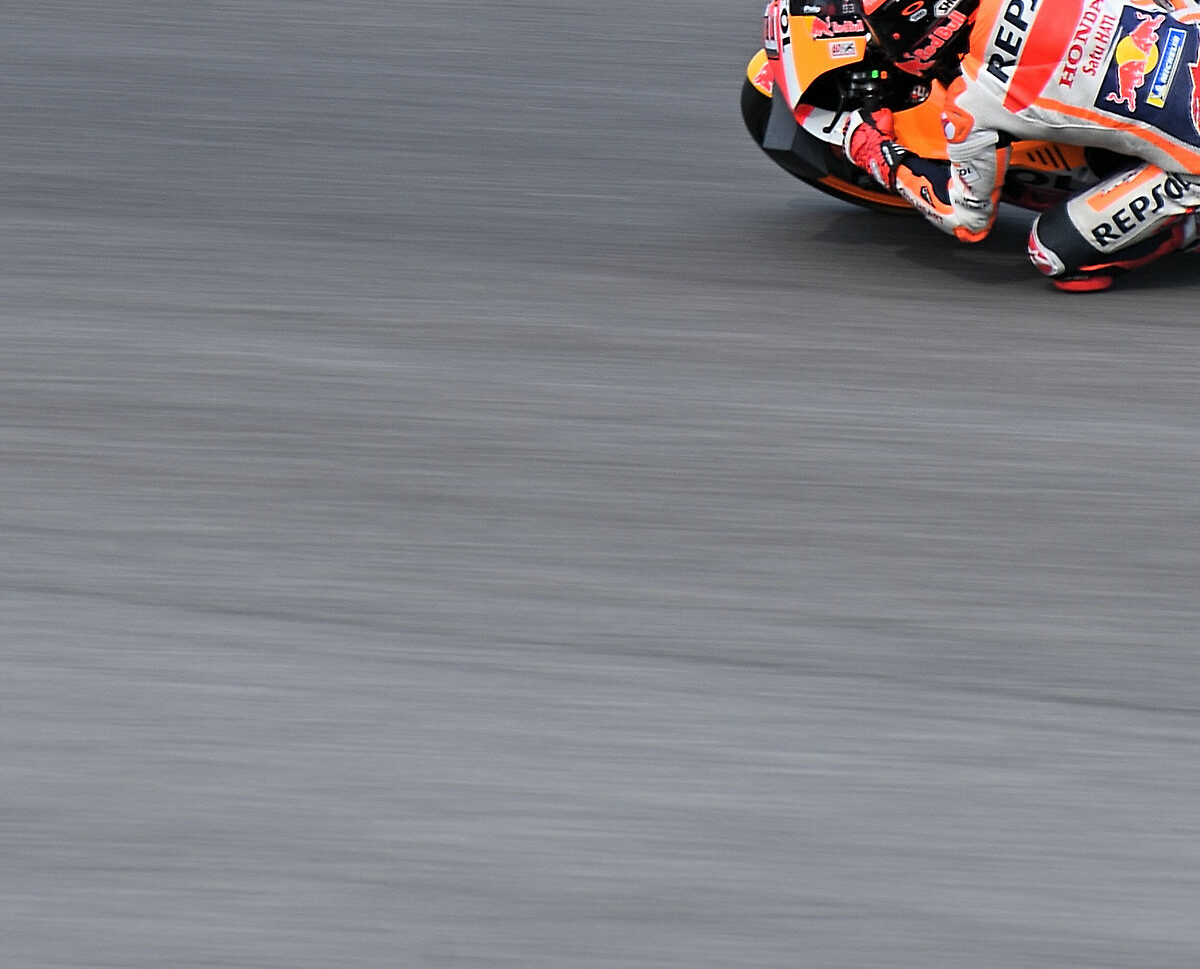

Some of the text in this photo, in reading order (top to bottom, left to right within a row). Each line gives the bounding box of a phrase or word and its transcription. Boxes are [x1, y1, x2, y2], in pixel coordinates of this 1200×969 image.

[1082, 14, 1117, 77] Satu HATI
[1091, 173, 1194, 248] REPSOL
